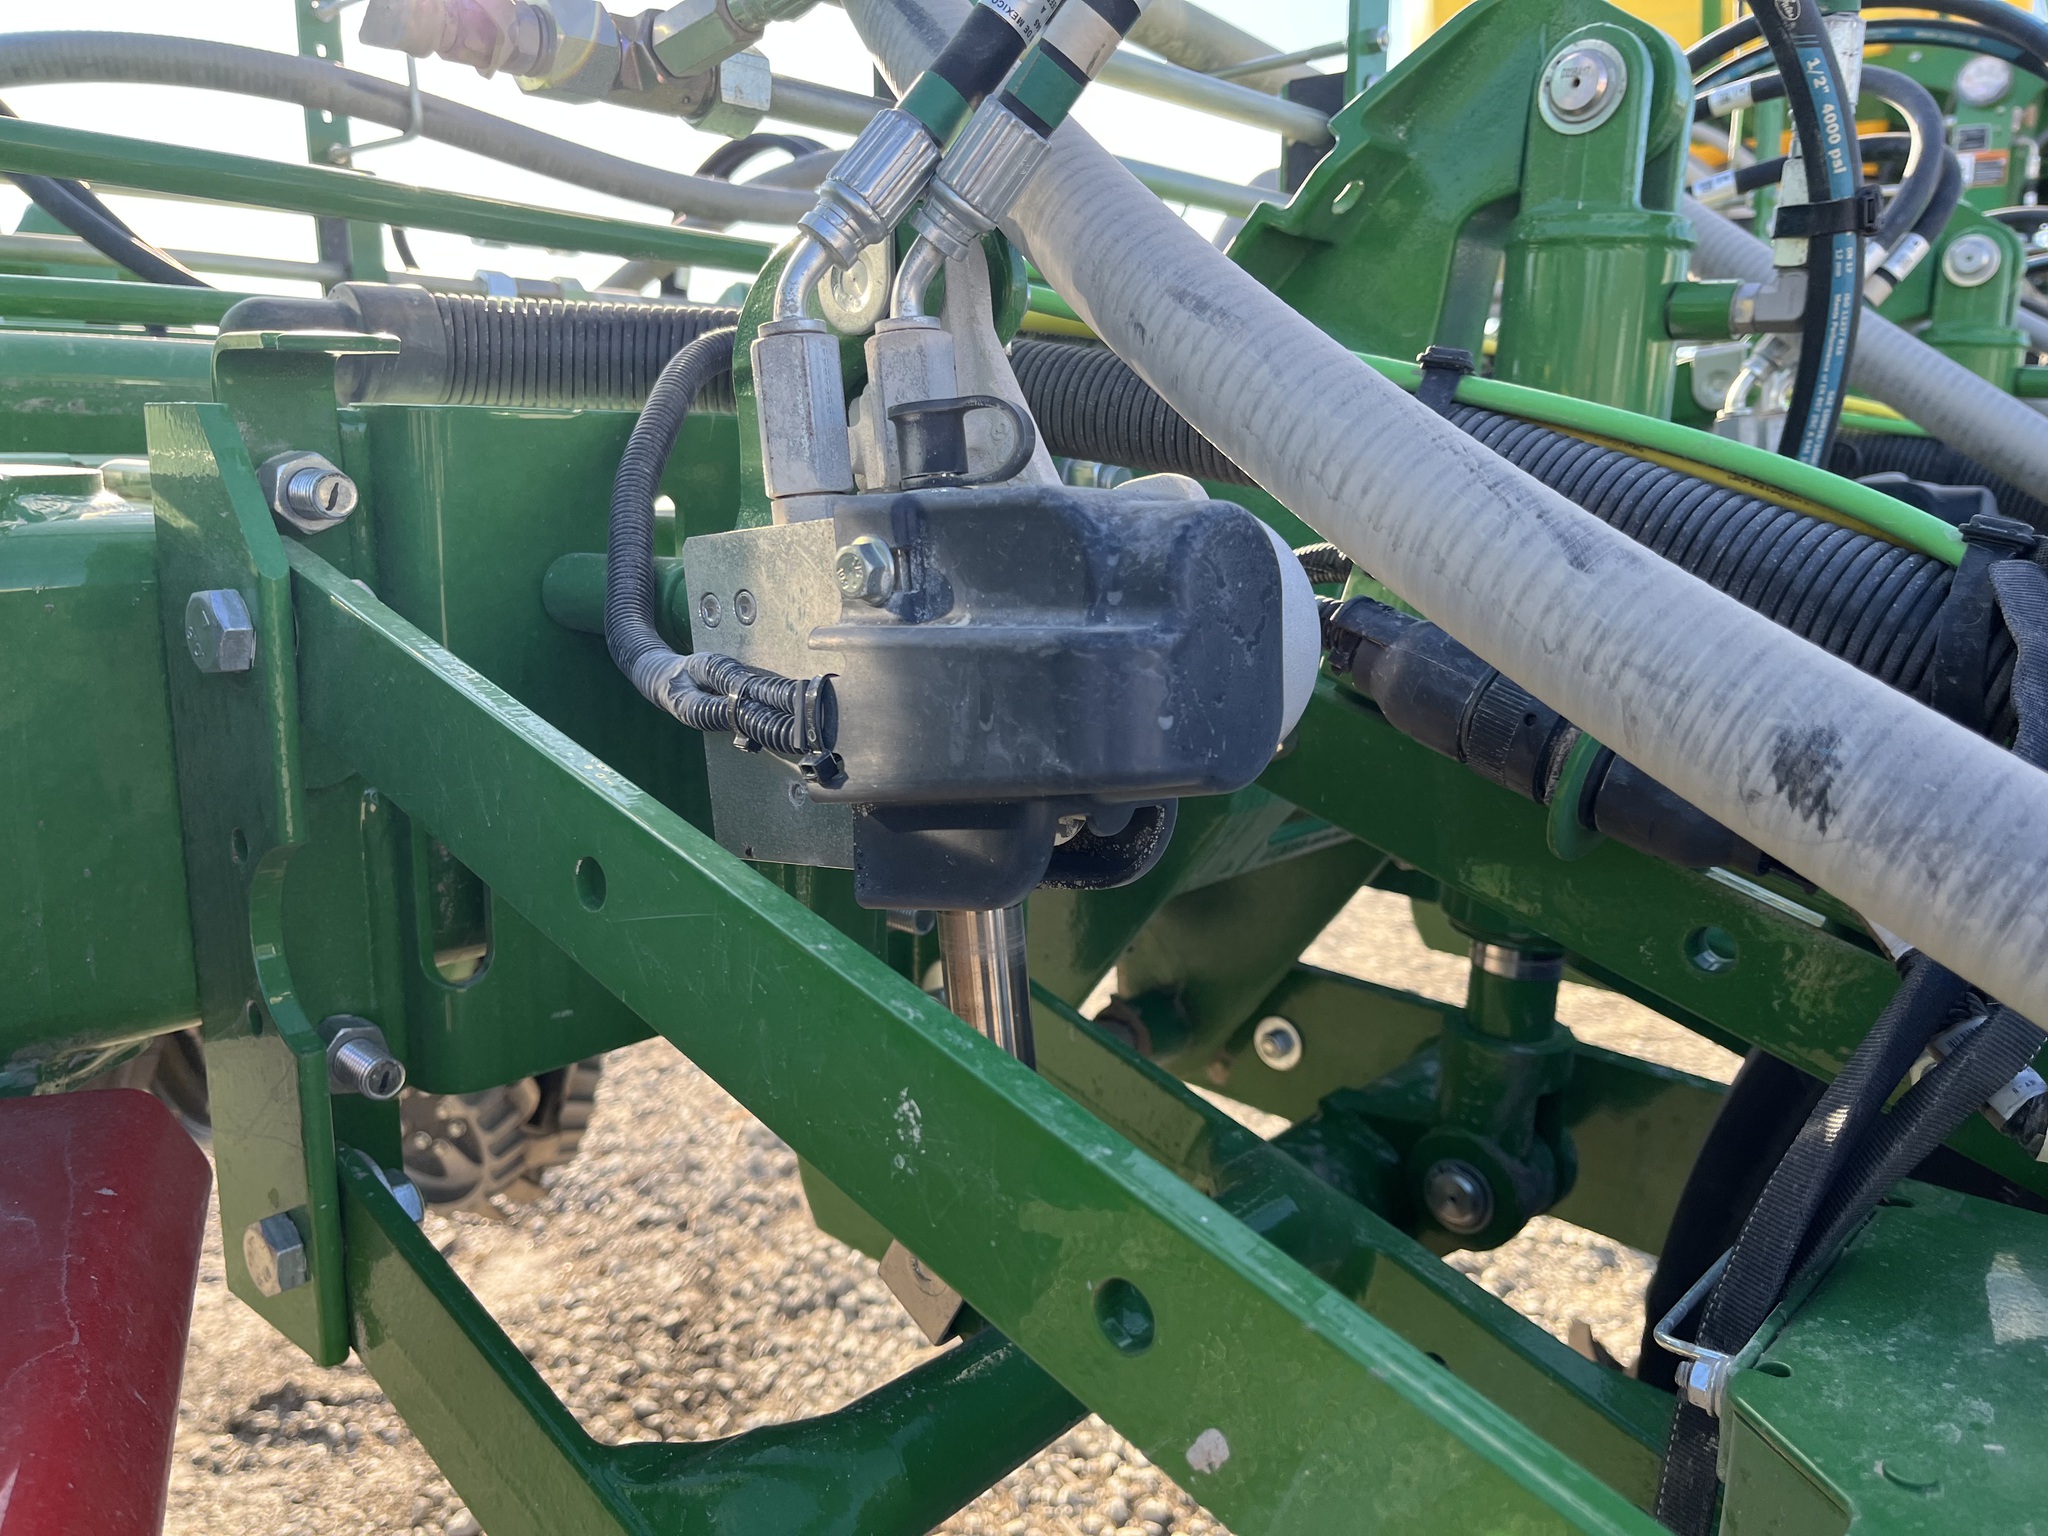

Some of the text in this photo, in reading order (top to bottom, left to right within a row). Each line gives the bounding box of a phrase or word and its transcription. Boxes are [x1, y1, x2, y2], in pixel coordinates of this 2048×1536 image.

[1023, 24, 1033, 38] DE
[1806, 57, 1848, 175] 1/2" 4000 psi
